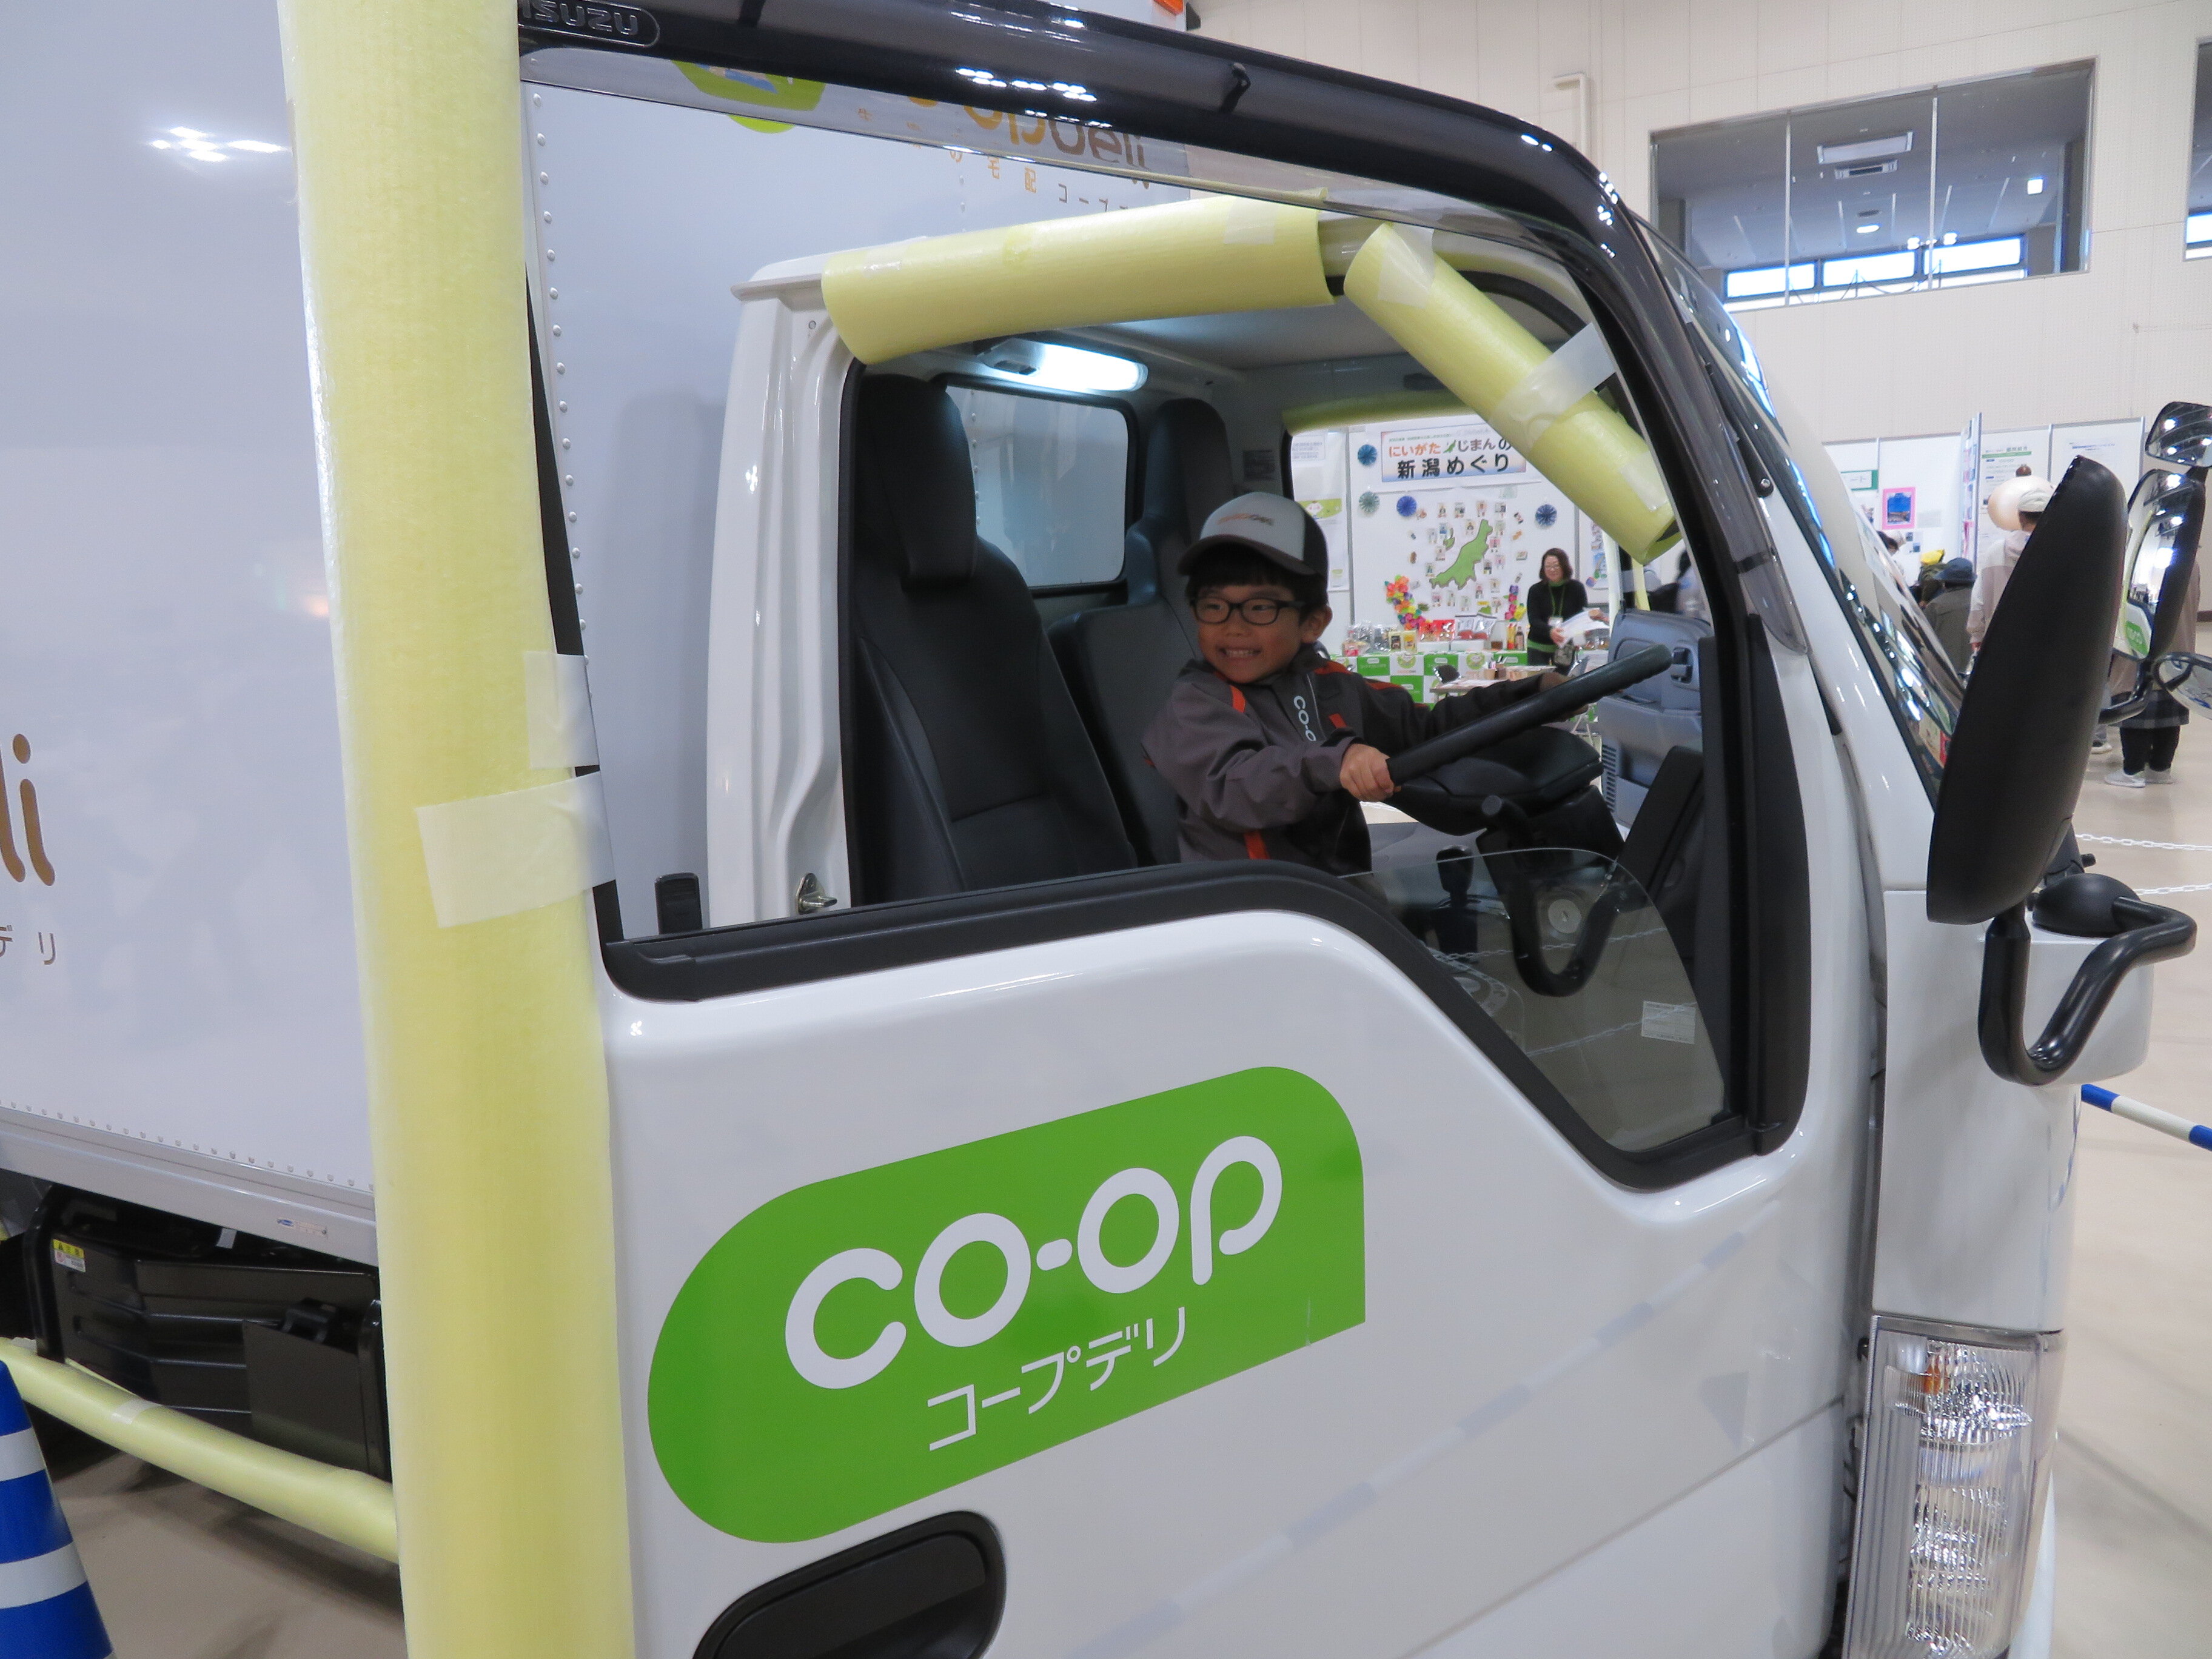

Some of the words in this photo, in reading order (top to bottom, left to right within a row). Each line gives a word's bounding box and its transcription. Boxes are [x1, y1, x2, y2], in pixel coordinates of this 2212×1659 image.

[522, 0, 638, 35] ISUZU
[1389, 442, 1441, 457] にいがた
[1458, 438, 1512, 452] じまんの
[1397, 454, 1509, 479] 新潟めぐり
[927, 1307, 1185, 1451] コープデリ
